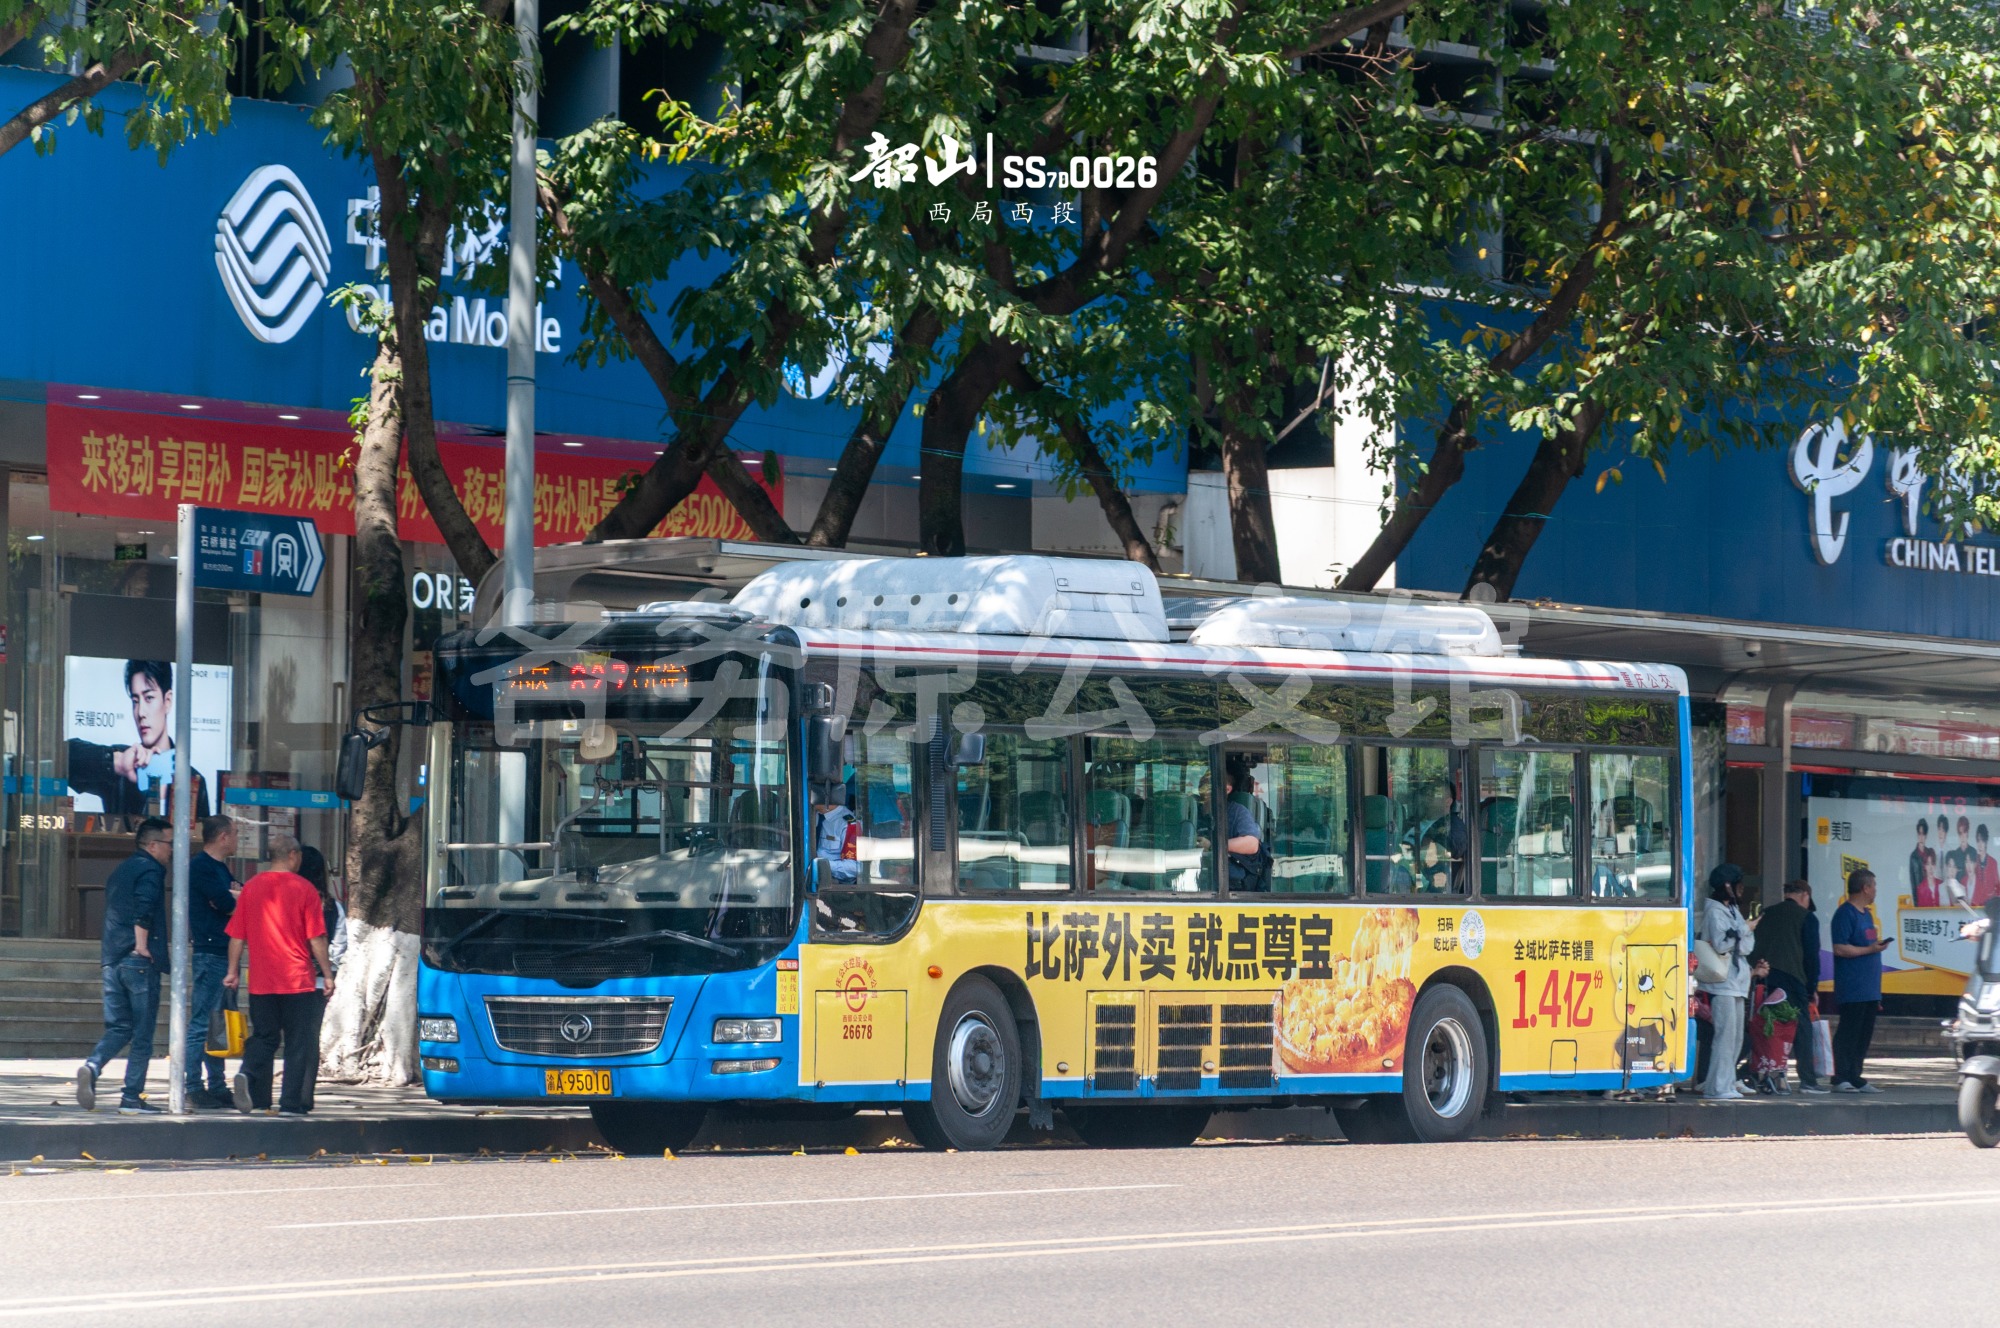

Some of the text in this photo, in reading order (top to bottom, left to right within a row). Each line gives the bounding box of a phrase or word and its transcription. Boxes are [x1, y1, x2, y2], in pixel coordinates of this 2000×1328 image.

[450, 296, 561, 353] Mole
[82, 429, 231, 504] 来移动享国补
[1886, 537, 1960, 572] CHINA
[190, 670, 208, 678] ONOR
[1620, 671, 1673, 689] 重庆公交
[74, 710, 115, 728] 荣耀500
[1437, 916, 1454, 932] 扫码
[1024, 911, 1333, 982] 比萨外卖 就点尊宝
[1433, 936, 1458, 952] 吃比萨
[1513, 939, 1594, 961] 全域比萨年销量
[842, 1024, 873, 1040] 26678
